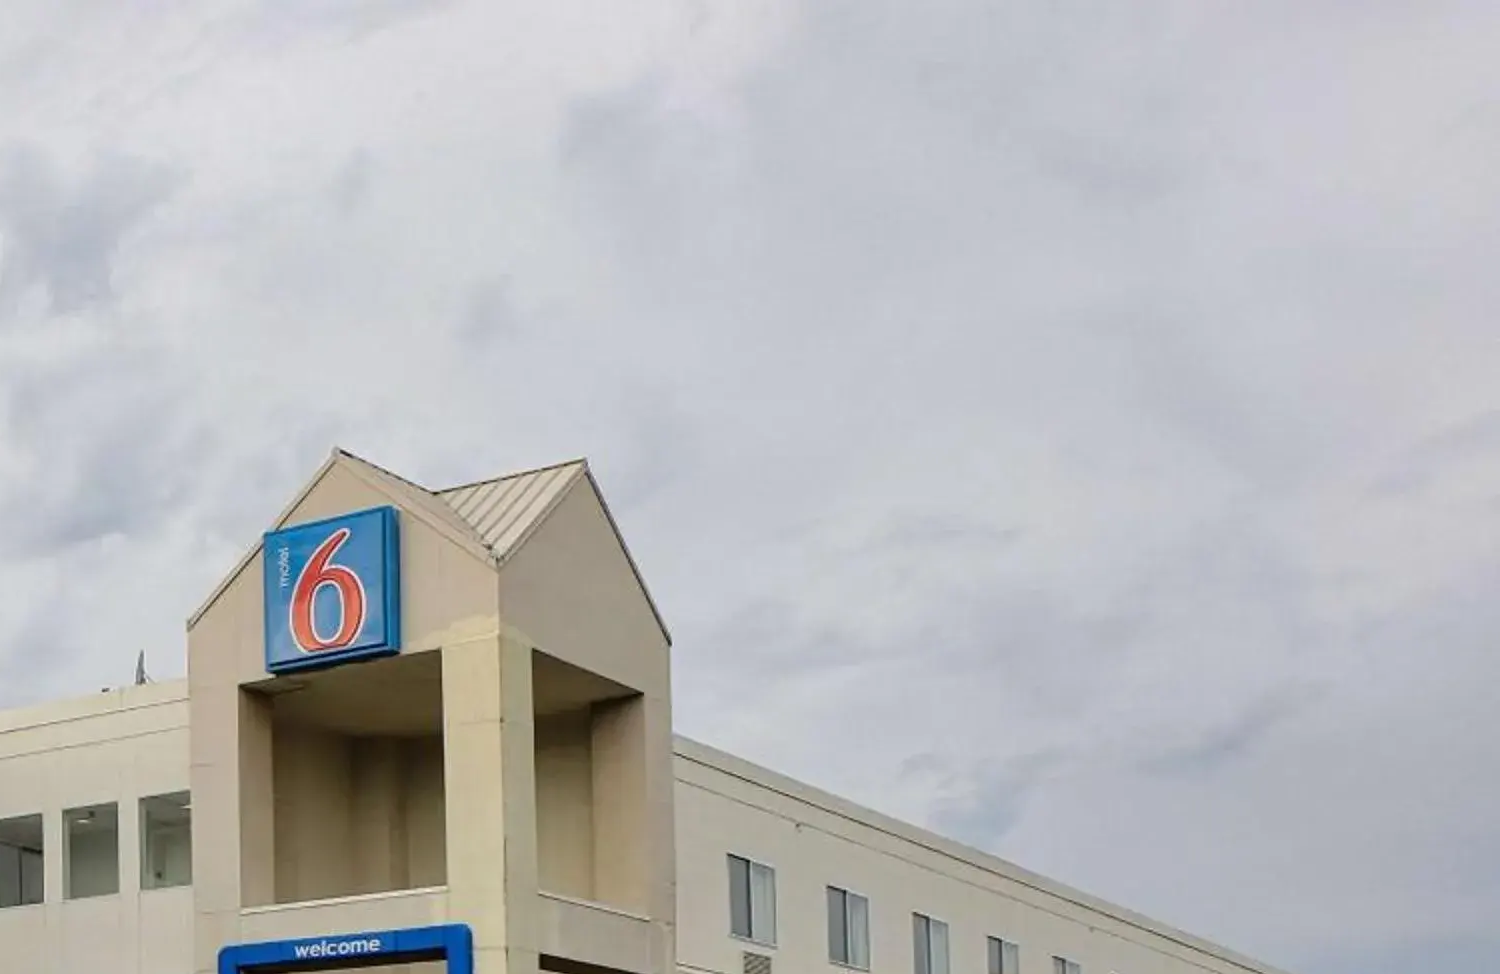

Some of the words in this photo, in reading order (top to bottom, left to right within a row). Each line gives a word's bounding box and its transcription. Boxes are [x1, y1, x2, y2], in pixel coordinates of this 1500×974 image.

[278, 547, 290, 588] motel
[289, 527, 367, 656] 6
[294, 938, 381, 959] welcome
